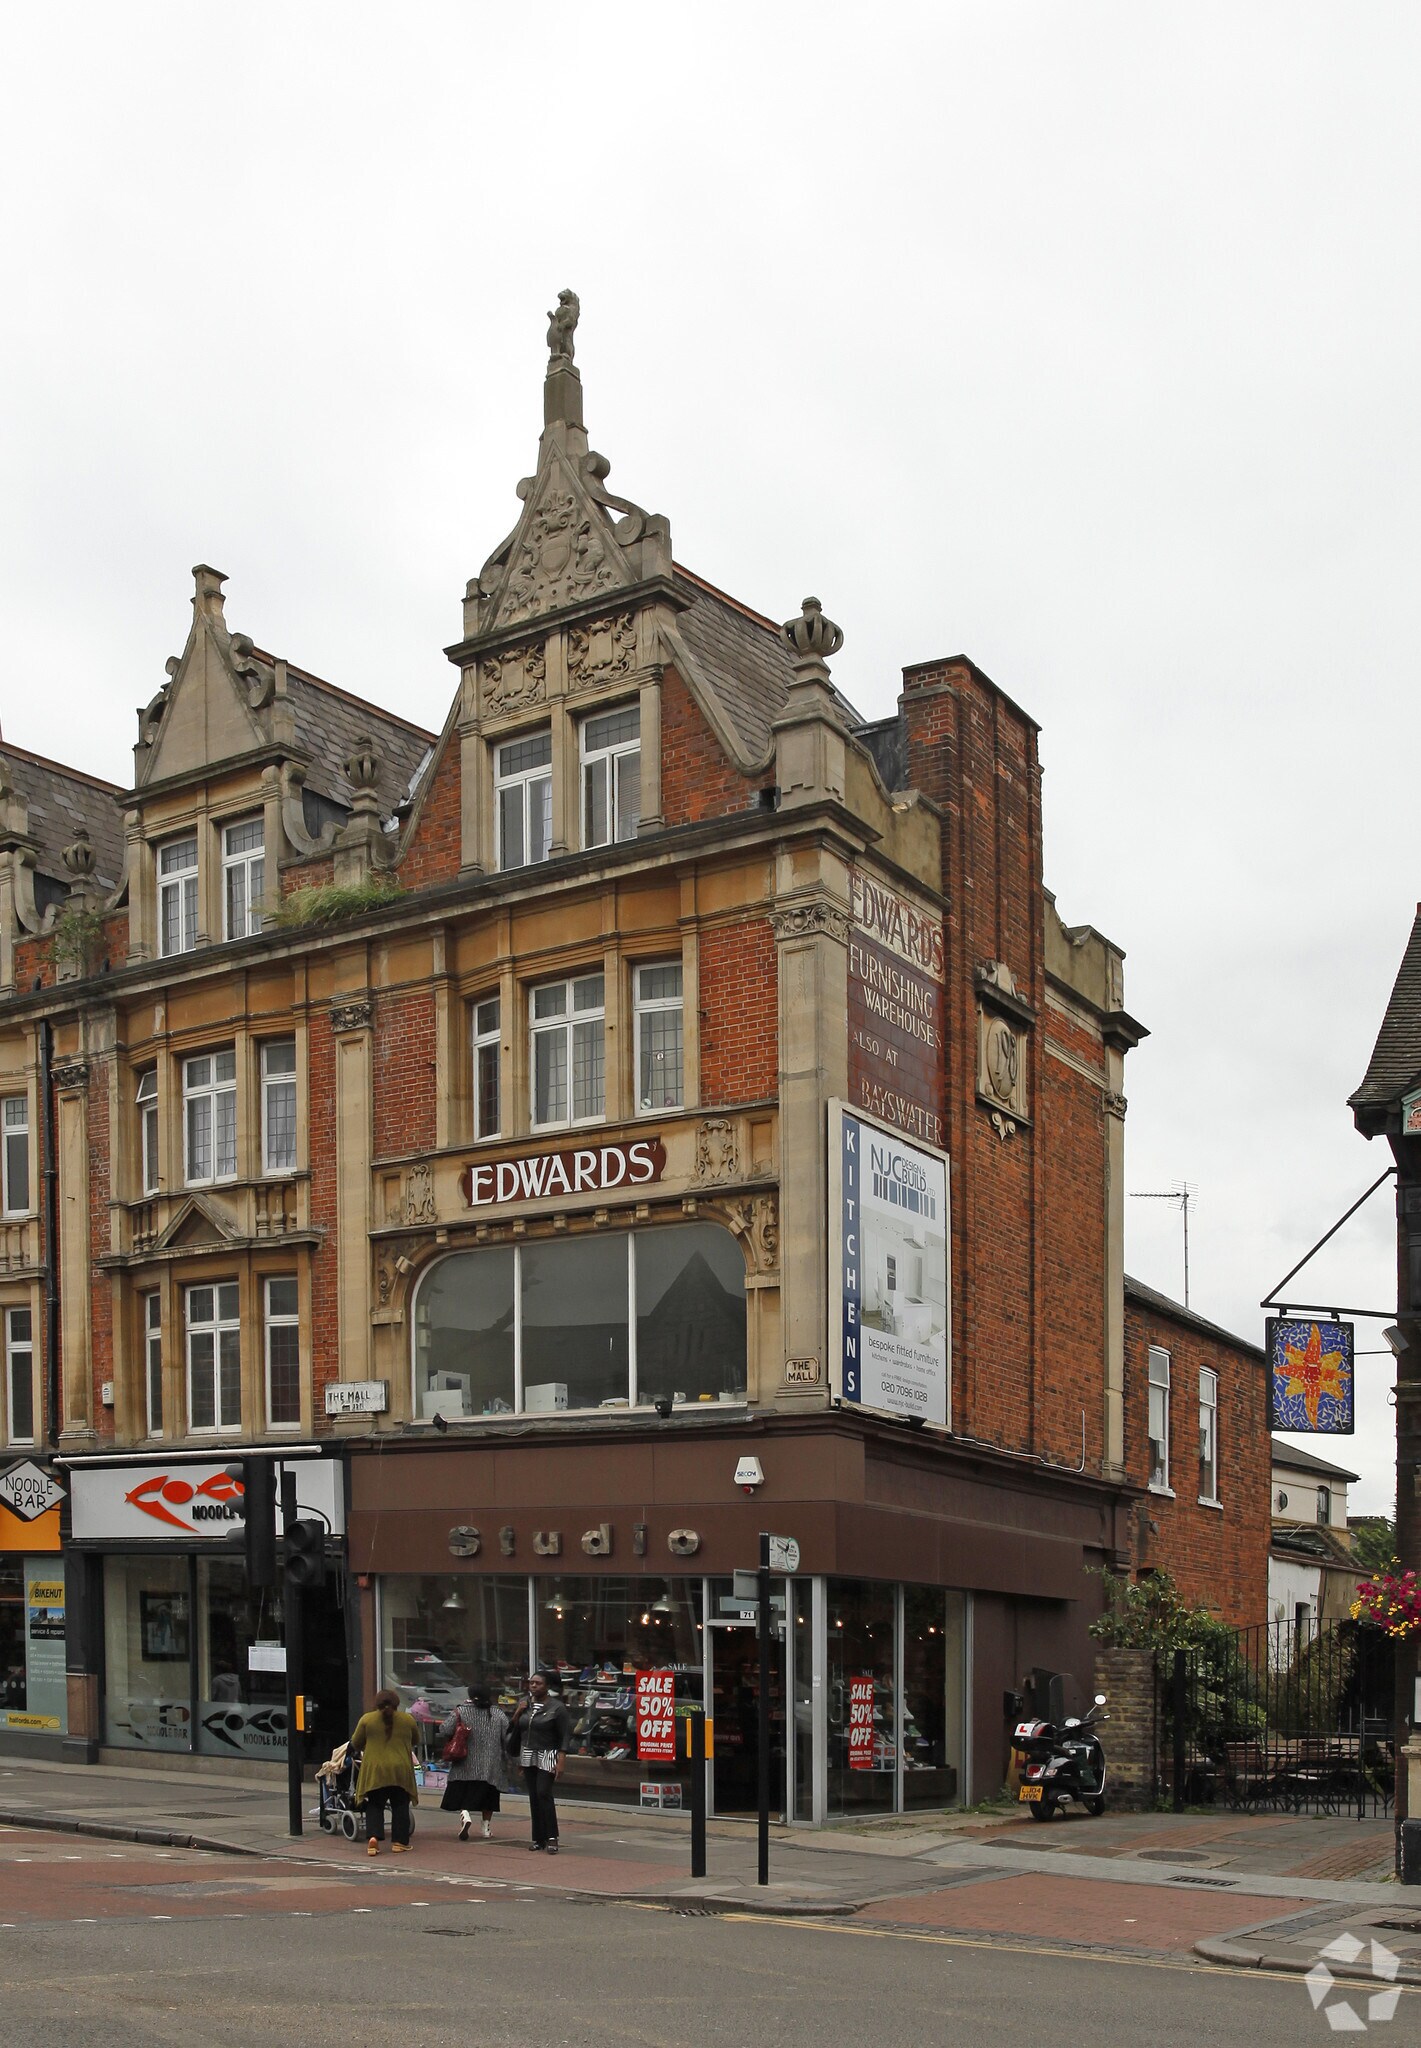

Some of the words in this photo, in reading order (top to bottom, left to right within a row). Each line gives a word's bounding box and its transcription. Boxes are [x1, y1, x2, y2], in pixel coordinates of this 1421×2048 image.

[848, 868, 944, 977] EDWARDS
[850, 943, 933, 1019] FURNISHING
[863, 984, 942, 1049] WAREHOUSES
[852, 1031, 879, 1056] ALSO
[885, 1048, 898, 1067] AT
[861, 1077, 945, 1146] BAYSWATER
[871, 1143, 902, 1183] NJC
[901, 1157, 922, 1176] DESIGN
[901, 1168, 927, 1192] BUILD
[846, 1129, 857, 1393] KITCHENS
[869, 1336, 895, 1353] bespoke
[896, 1344, 912, 1359] fitted
[914, 1350, 939, 1367] furniture
[792, 1360, 810, 1371] THE
[788, 1371, 814, 1382] MALL
[327, 1391, 344, 1402] THE
[348, 1390, 371, 1401] MALL
[881, 1381, 895, 1394] 020
[896, 1384, 914, 1398] 7096
[5, 1476, 53, 1495] NOODLE
[14, 1491, 47, 1510] BAR
[34, 1588, 63, 1599] BIKEHUT
[668, 1662, 687, 1671] SALE
[638, 1677, 673, 1694] SALE
[851, 1683, 873, 1700] SALE
[639, 1696, 674, 1718] 50%
[851, 1703, 873, 1725] 50%
[640, 1720, 673, 1739] OFF
[851, 1727, 872, 1747] OFF
[1019, 1725, 1027, 1733] L
[243, 1732, 270, 1746] NOODLE
[272, 1733, 288, 1747] BAR
